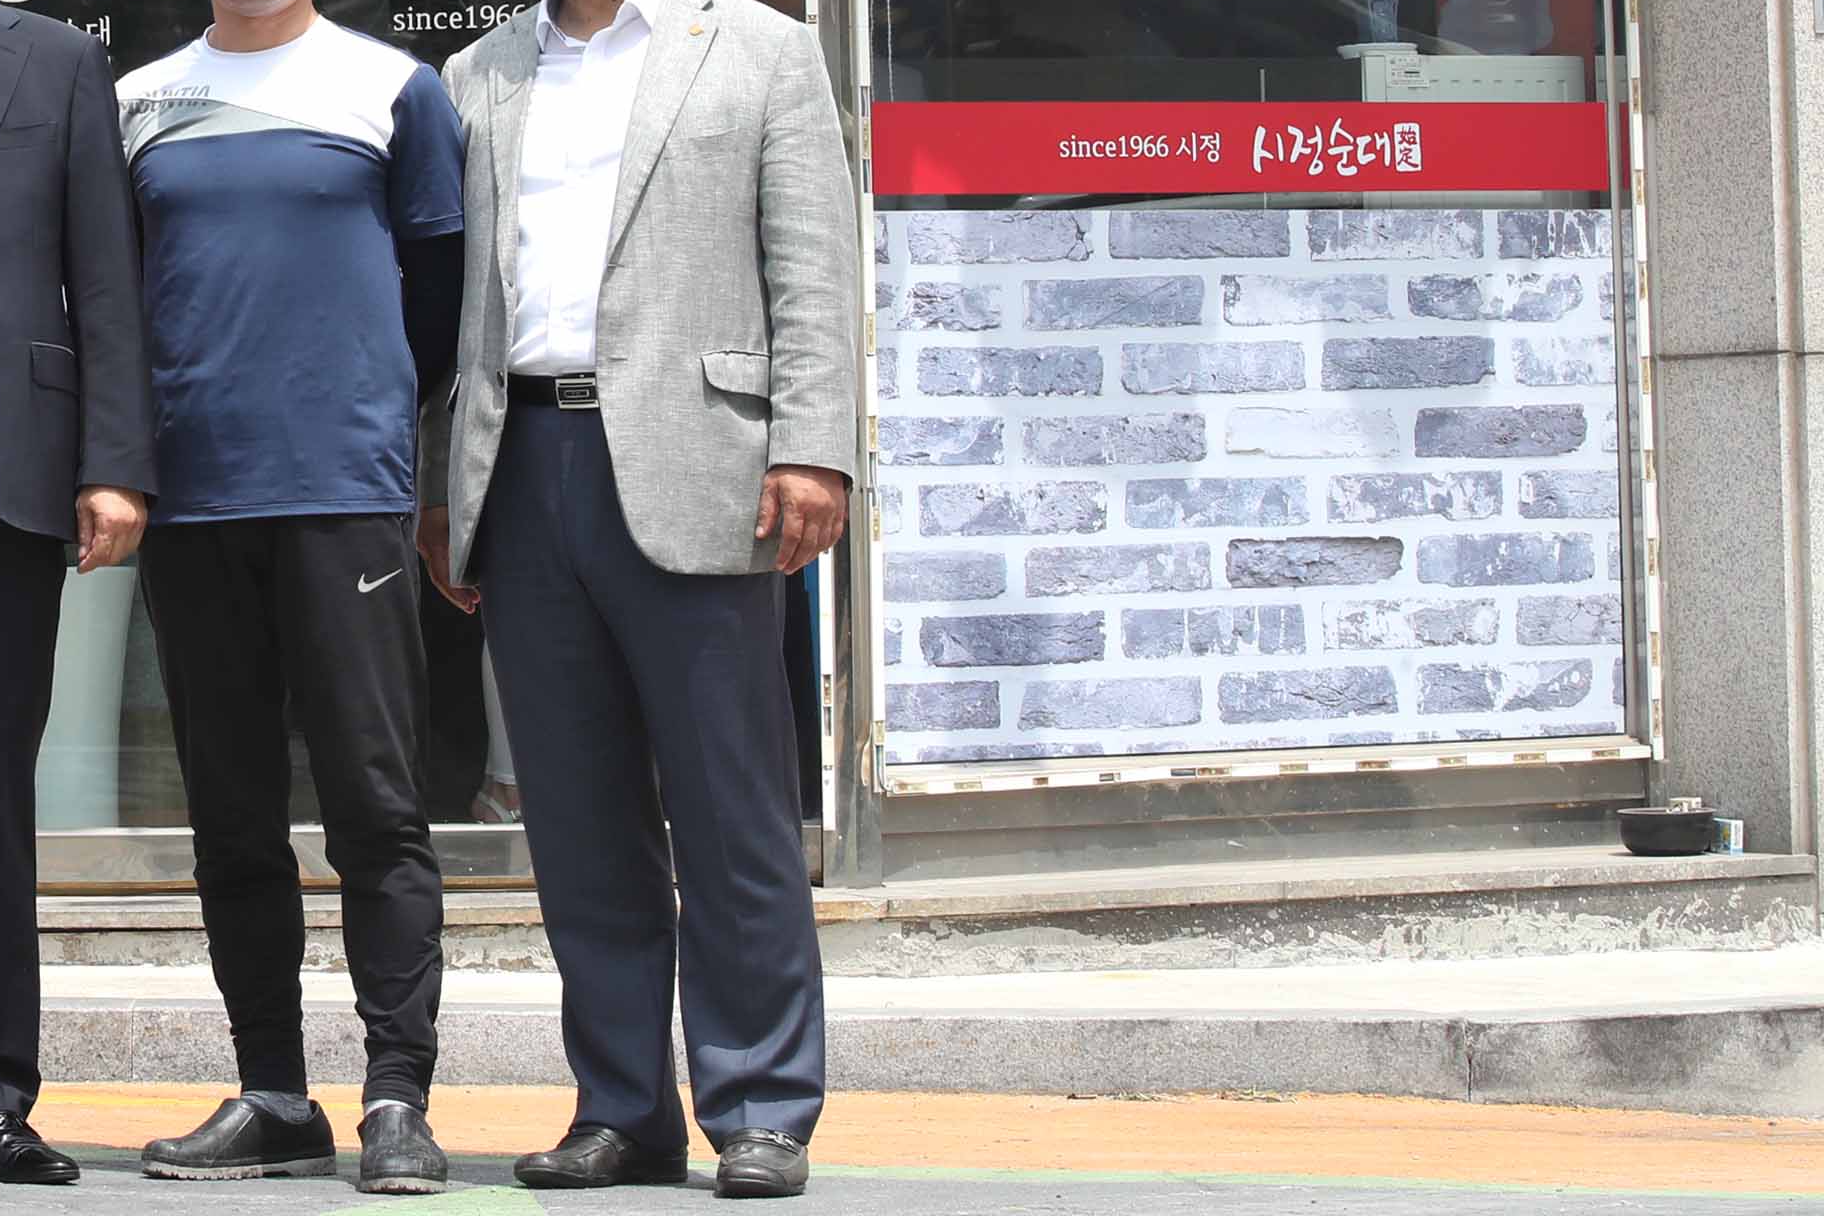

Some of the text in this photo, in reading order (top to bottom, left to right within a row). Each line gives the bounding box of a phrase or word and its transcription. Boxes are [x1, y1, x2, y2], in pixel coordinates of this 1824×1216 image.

[1059, 132, 1221, 163] since1966 시정
[1252, 117, 1391, 176] 시정순대
